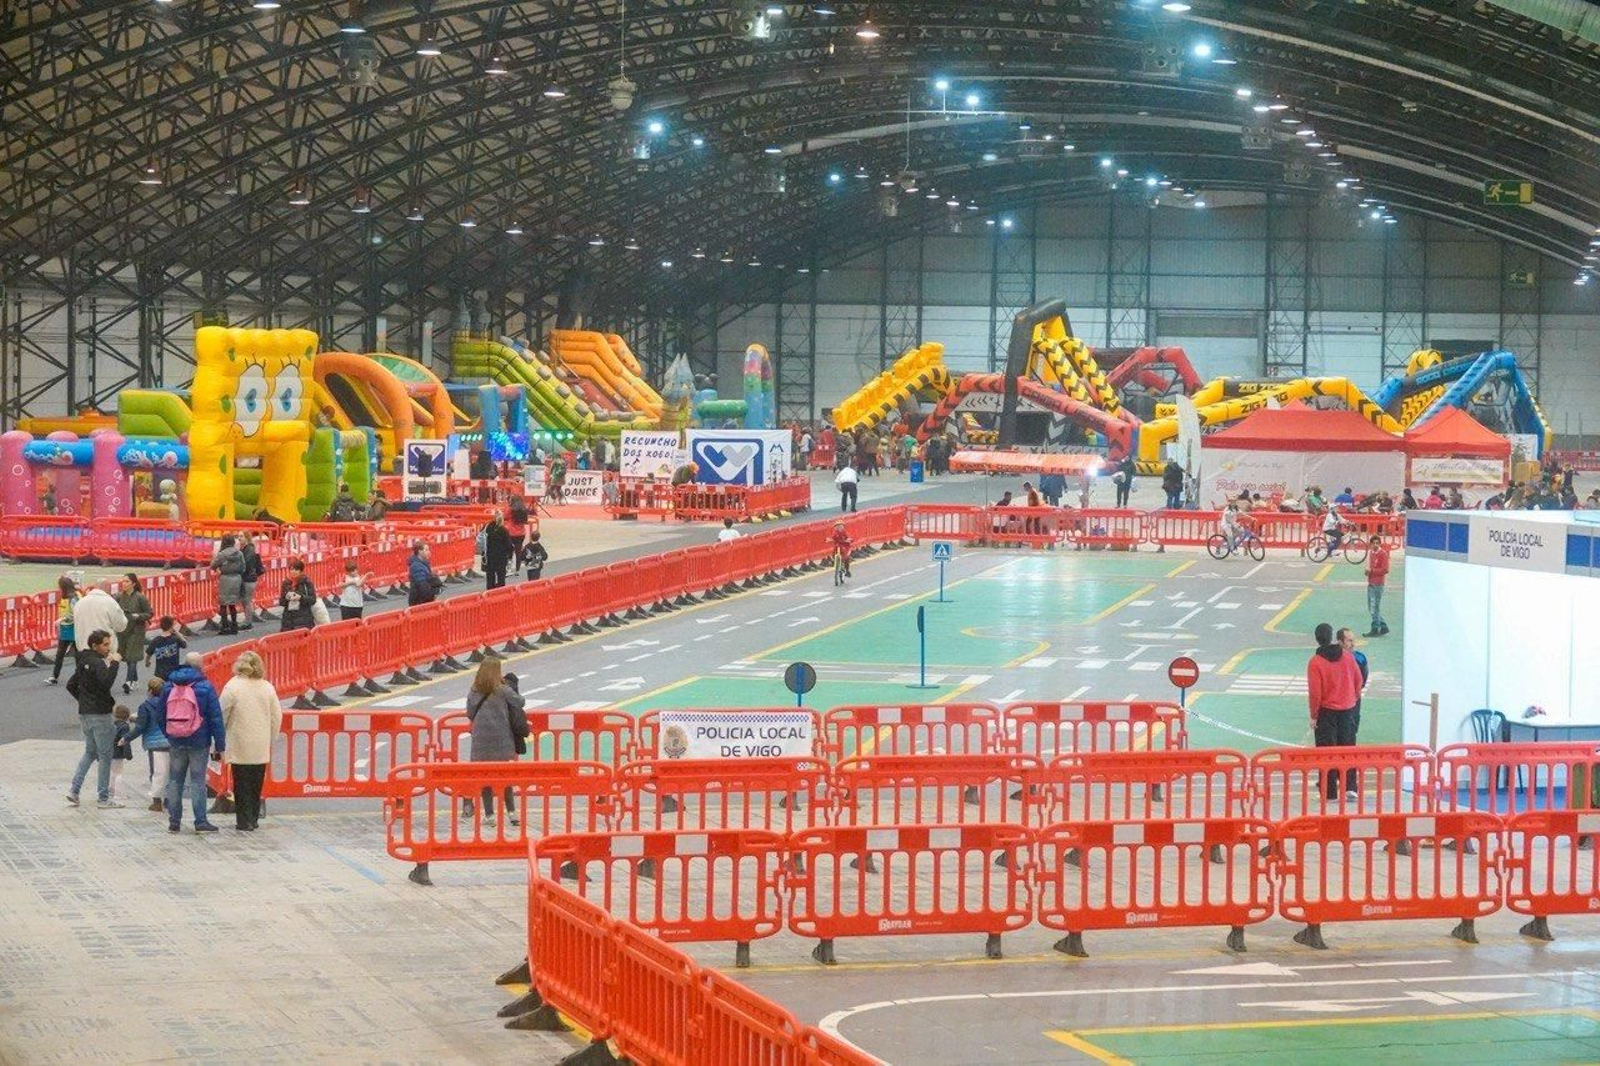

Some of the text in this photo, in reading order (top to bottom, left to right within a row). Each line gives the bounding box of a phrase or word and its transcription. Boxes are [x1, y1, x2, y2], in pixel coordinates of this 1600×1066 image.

[624, 436, 677, 447] RECUNCHO
[623, 448, 642, 457] DOS
[568, 476, 594, 486] JUST
[564, 487, 598, 497] DANCE
[1518, 532, 1544, 547] LOCAL
[1500, 545, 1531, 559] DE VIGO
[696, 726, 806, 739] POLICIA LOCAL
[720, 745, 782, 758] DE VIGO
